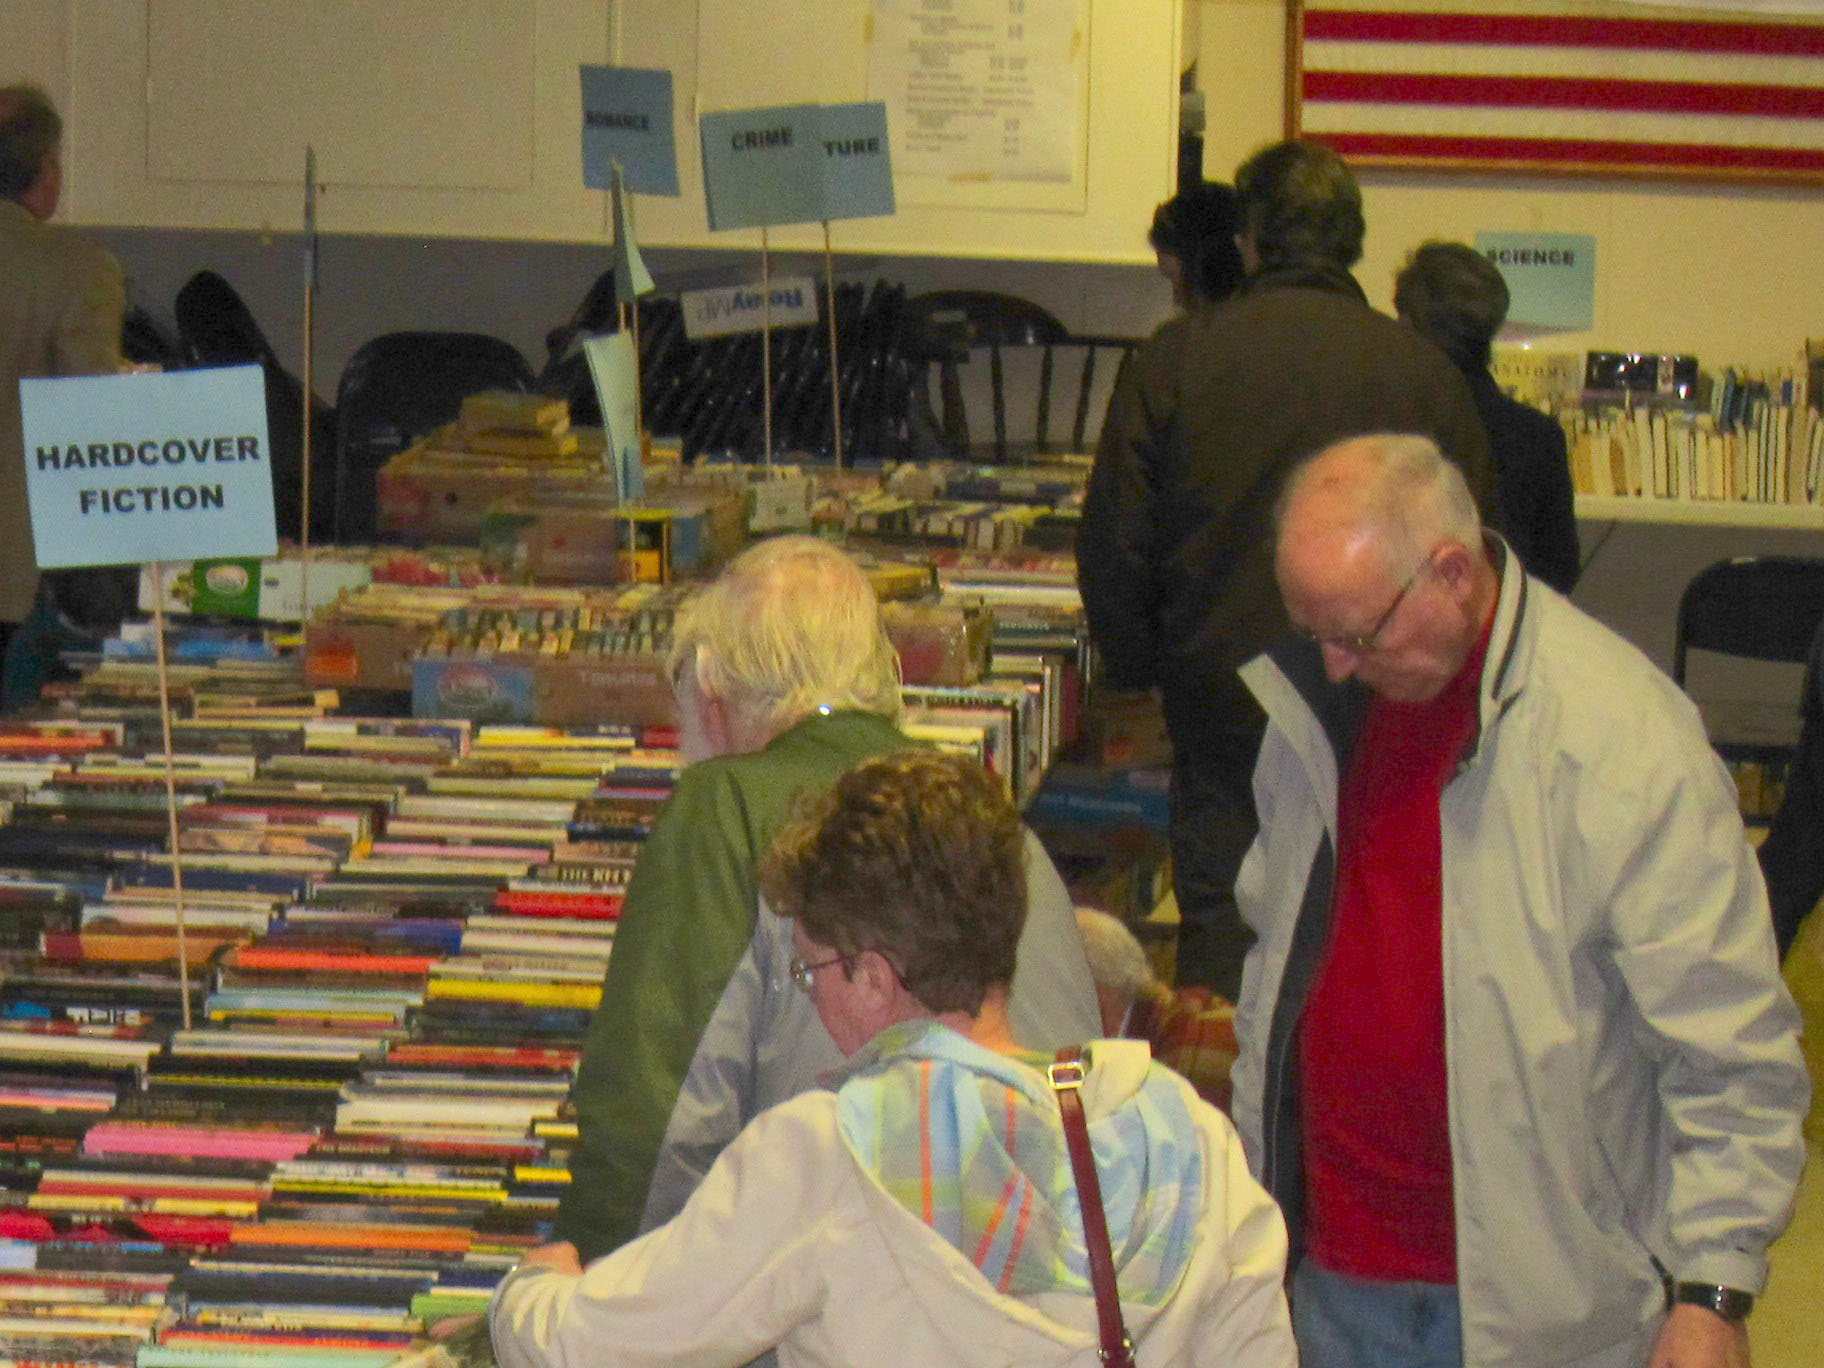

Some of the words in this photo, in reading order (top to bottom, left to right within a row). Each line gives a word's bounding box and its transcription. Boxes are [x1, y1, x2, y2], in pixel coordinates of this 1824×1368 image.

[732, 127, 792, 150] CRIME
[823, 136, 880, 157] TURE
[1487, 247, 1575, 268] SCIENCE
[36, 436, 260, 471] HARDCOVER
[79, 484, 225, 515] FICTION
